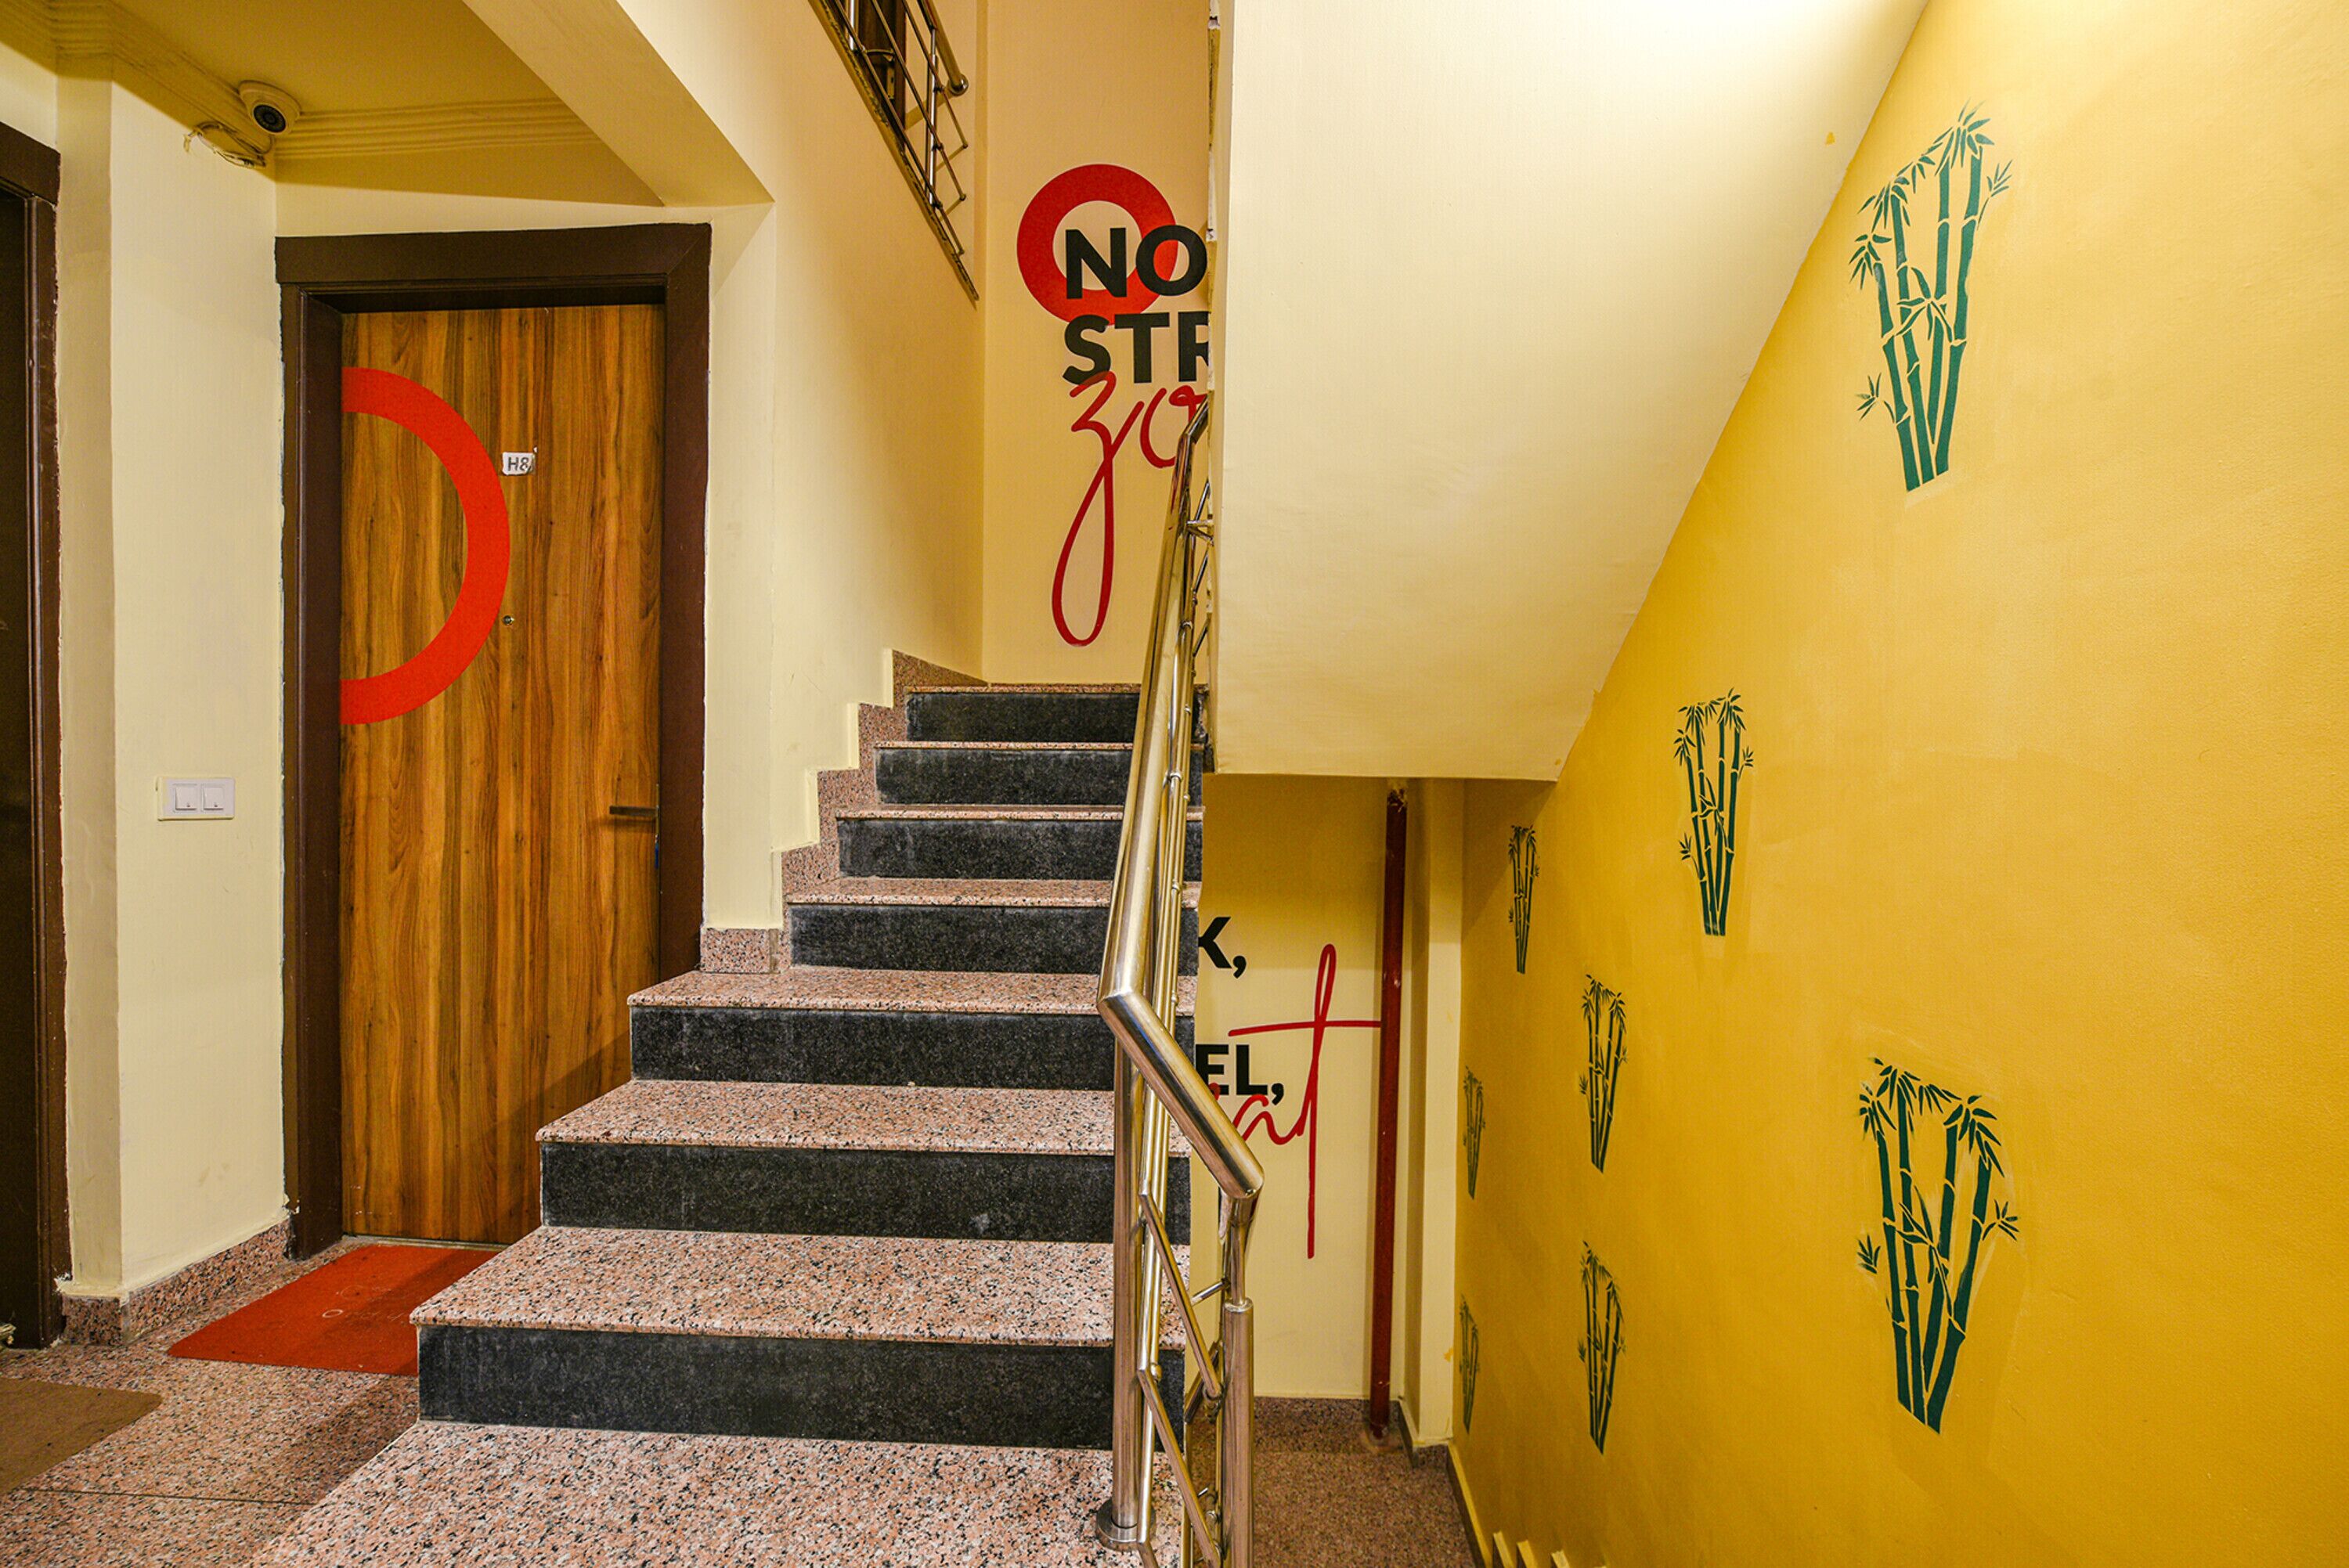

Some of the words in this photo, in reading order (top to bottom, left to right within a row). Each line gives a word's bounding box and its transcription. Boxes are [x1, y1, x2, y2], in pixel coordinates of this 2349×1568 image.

[1065, 225, 1208, 300] NO
[1063, 311, 1209, 386] STR
[507, 456, 530, 472] H8
[1196, 1044, 1284, 1105] EL,
[1207, 943, 1382, 1259] at
